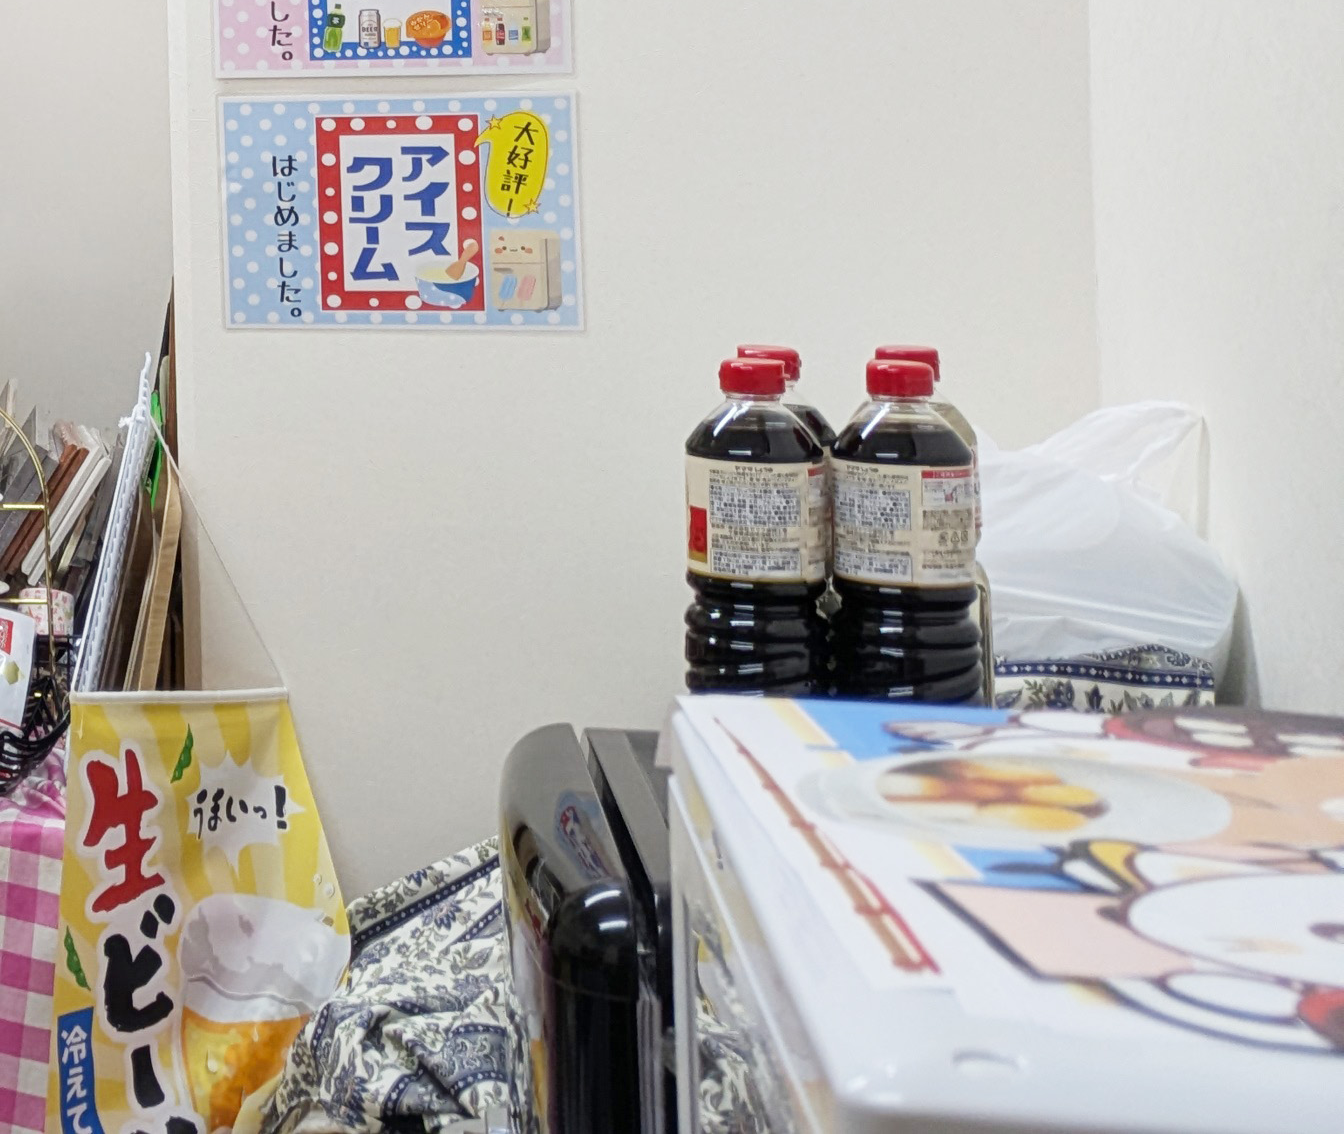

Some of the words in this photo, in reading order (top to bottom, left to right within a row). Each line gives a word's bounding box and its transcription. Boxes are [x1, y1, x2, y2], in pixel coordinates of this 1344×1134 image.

[346, 156, 400, 282] クリーム
[400, 145, 452, 257] アイス
[82, 748, 199, 1134] 生ビー
